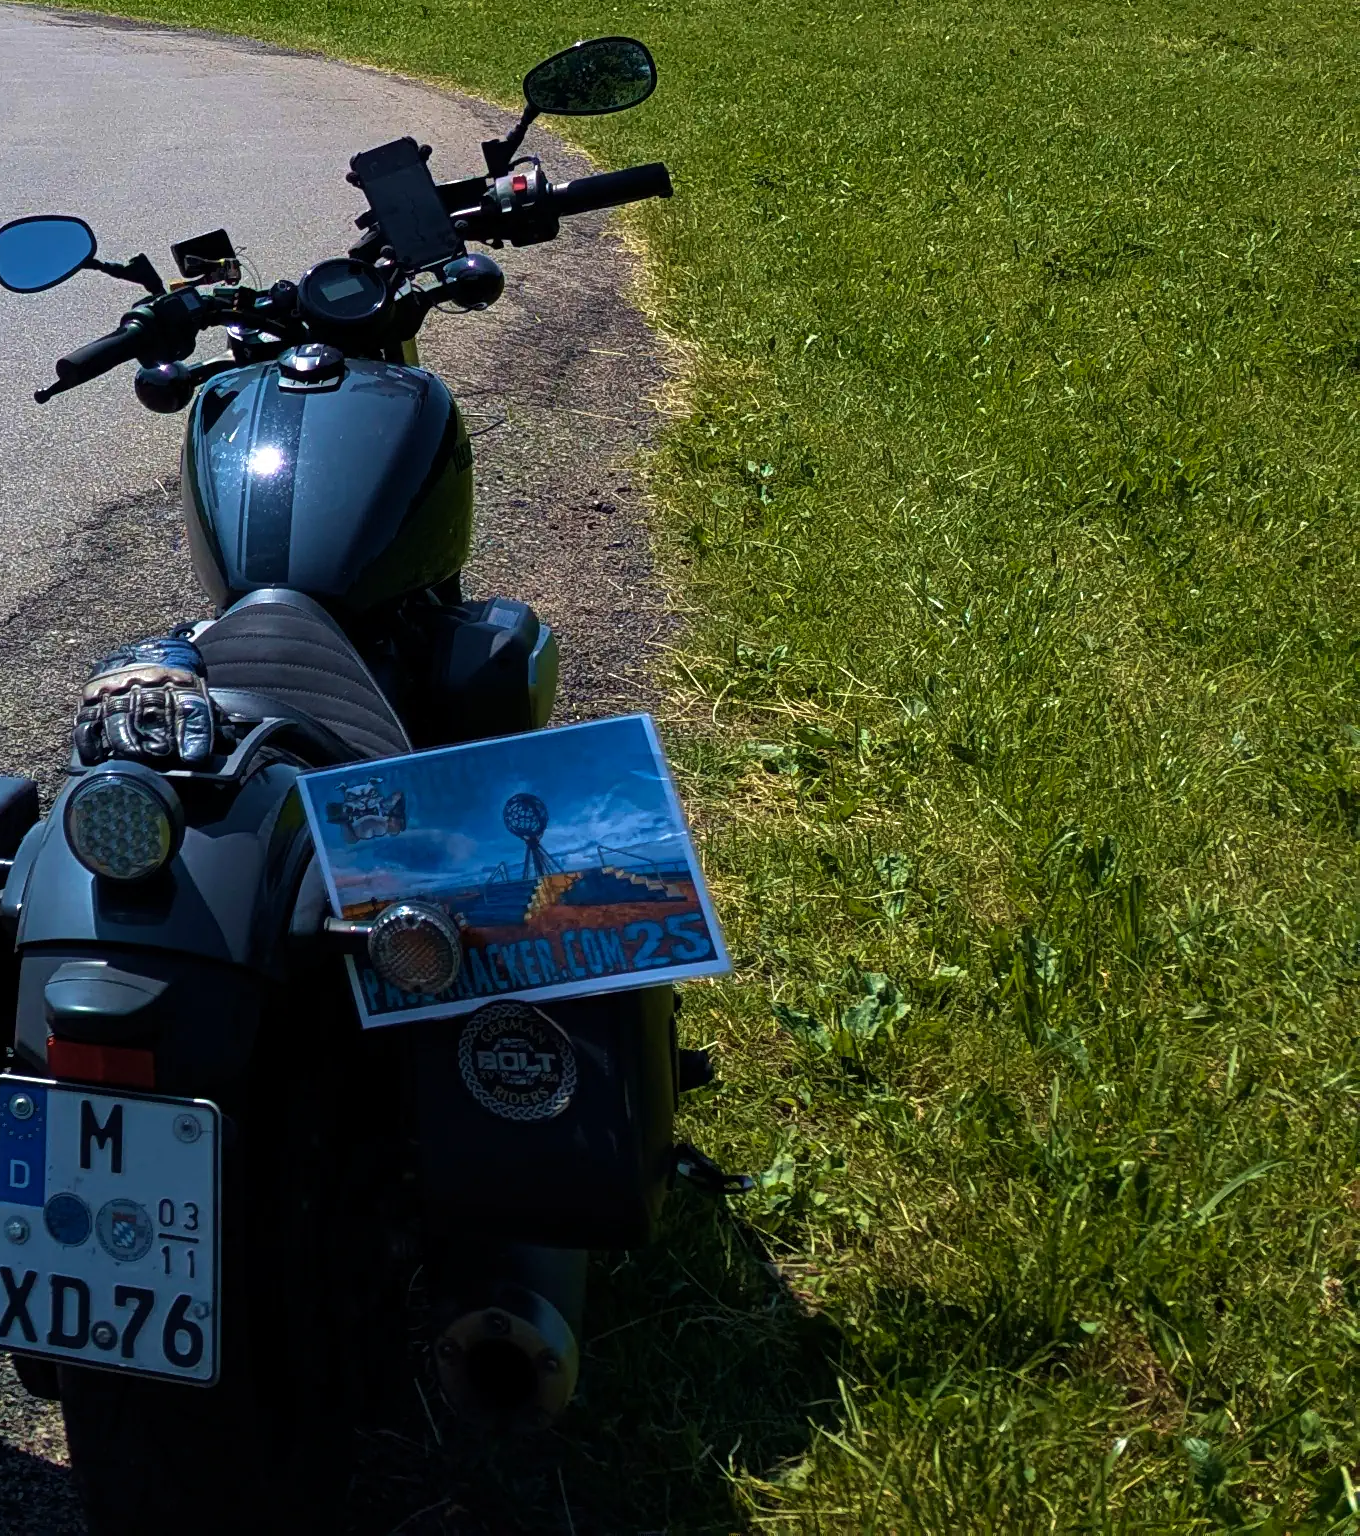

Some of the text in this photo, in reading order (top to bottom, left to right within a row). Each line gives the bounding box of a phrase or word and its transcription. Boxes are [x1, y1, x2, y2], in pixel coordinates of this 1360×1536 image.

[623, 912, 711, 968] 25
[480, 1019, 547, 1045] GERMAN
[476, 1051, 556, 1073] BOLT
[492, 1085, 550, 1105] RIDERS
[80, 1099, 124, 1174] M
[9, 1159, 30, 1189] D
[158, 1197, 199, 1231] 03
[160, 1245, 196, 1279] 11
